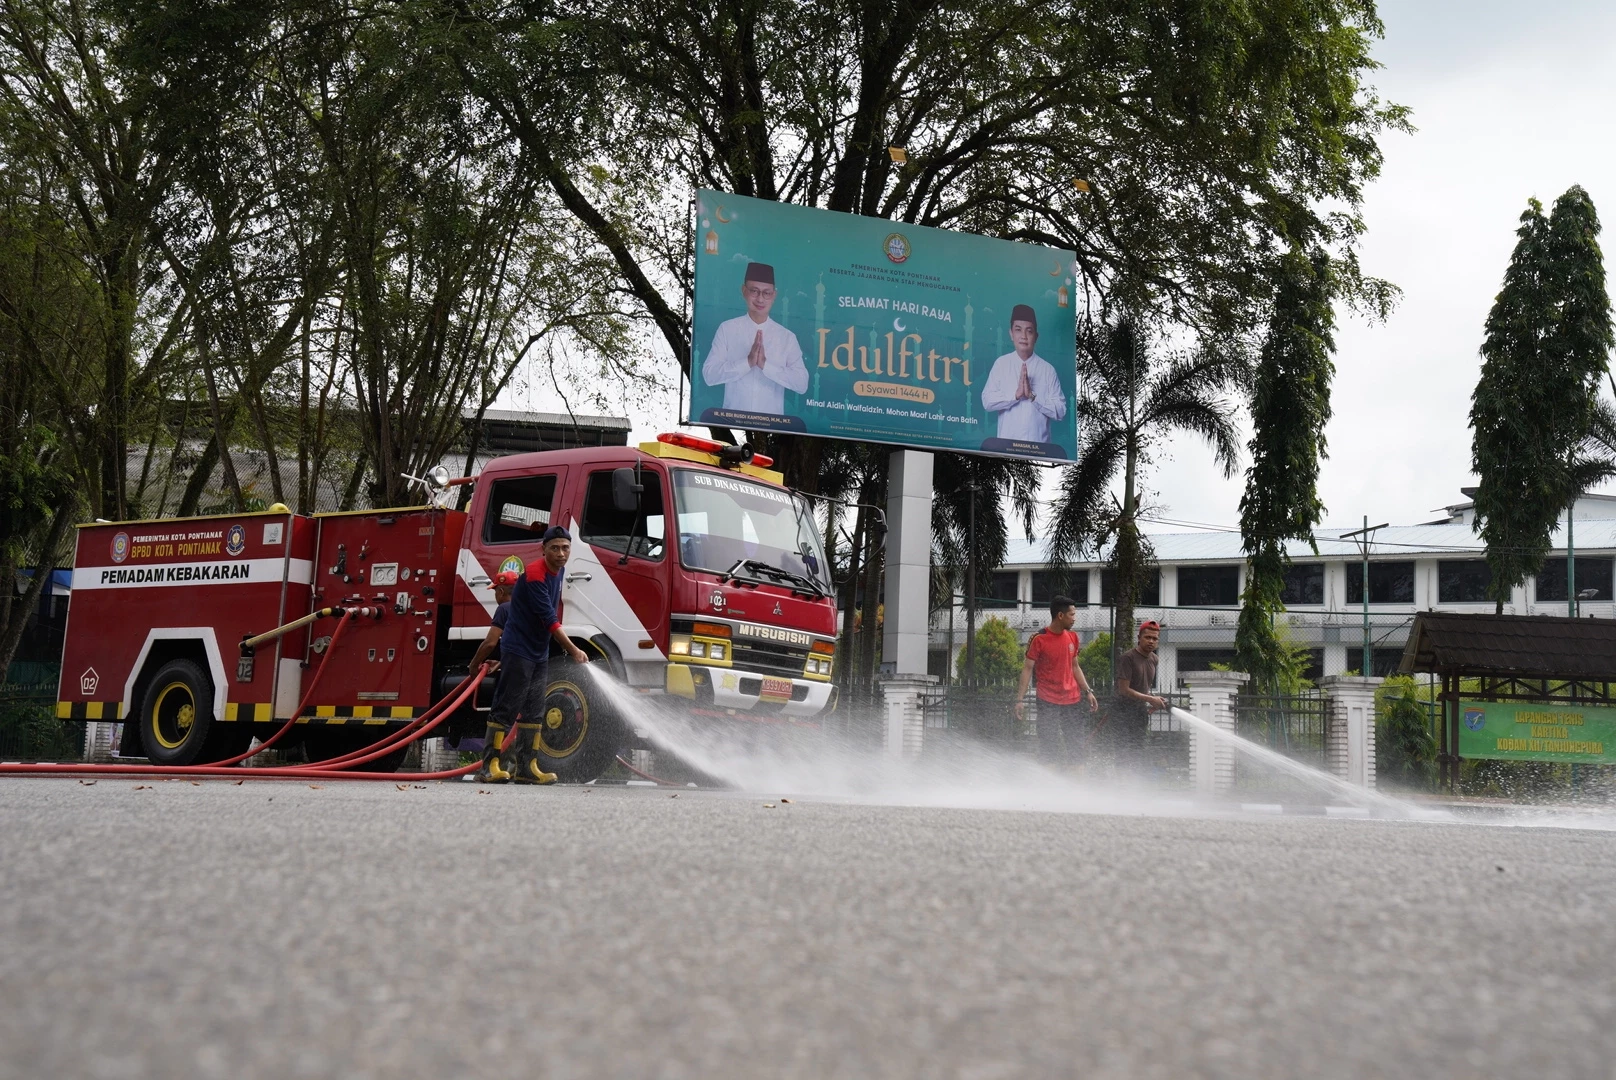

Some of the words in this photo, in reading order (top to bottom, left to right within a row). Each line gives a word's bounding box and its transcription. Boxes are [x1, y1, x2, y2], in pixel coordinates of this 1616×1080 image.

[830, 268, 855, 277] BESERTA
[858, 272, 885, 280] JAJARAN
[917, 281, 961, 292] MENGUCAPKAN
[851, 264, 888, 274] PEMERINTAH
[907, 272, 940, 282] PONTIANAK
[838, 296, 889, 310] SELAMAT
[892, 300, 919, 314] HARI
[922, 306, 952, 322] RAYA
[816, 326, 972, 386] Idulfitri
[860, 384, 864, 392] 1
[866, 384, 898, 398] Syawal
[900, 388, 920, 398] 1444
[806, 399, 825, 408] Minal
[826, 401, 845, 410] Aidin
[886, 408, 908, 417] Mohon
[910, 410, 928, 419] Maaf
[928, 413, 945, 421] Lahir
[946, 414, 960, 423] dan
[961, 416, 978, 425] Batin
[695, 476, 712, 486] SUB
[714, 478, 738, 492] DINAS
[739, 484, 784, 503] KEBAKARAN
[133, 534, 169, 543] PEMERINTAH
[188, 531, 223, 540] PONTIANAK
[131, 545, 151, 558] BPBD
[155, 544, 173, 557] KOTA
[178, 542, 221, 556] PONTIANAK
[101, 568, 164, 584] PEMADAM
[166, 564, 250, 581] KEBAKARAN
[740, 624, 810, 644] MITSUBISHI
[83, 678, 95, 690] 02
[1515, 711, 1558, 725] LAPANGAN
[1560, 713, 1584, 726] TENIS
[1532, 726, 1568, 738] KARTIKA
[1497, 738, 1527, 751] KODAM
